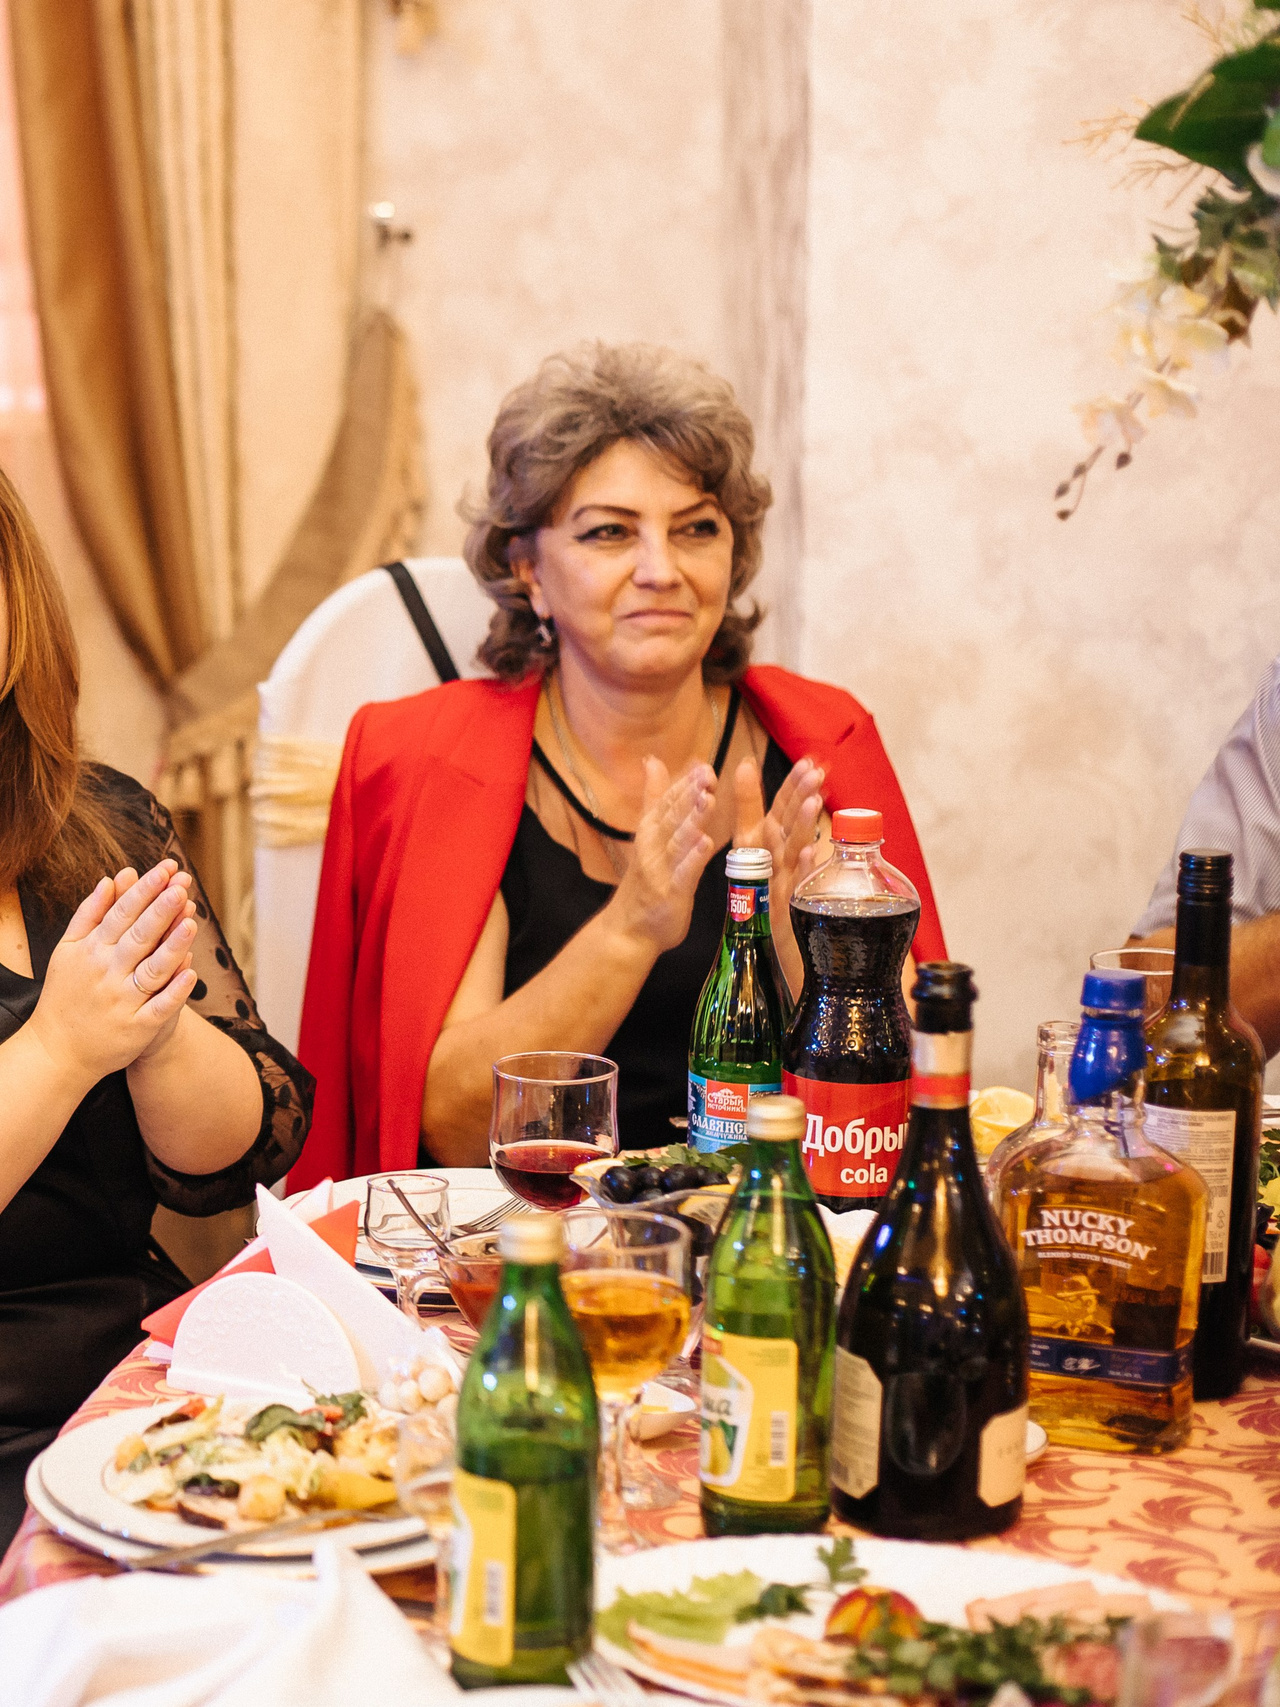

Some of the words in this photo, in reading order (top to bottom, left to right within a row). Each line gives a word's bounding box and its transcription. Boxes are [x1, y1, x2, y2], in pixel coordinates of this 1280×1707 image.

[730, 899, 747, 914] 1500
[707, 1093, 744, 1106] Старый
[840, 1163, 888, 1184] cola
[1040, 1209, 1136, 1236] NUCKY
[1021, 1228, 1153, 1260] THOMPSON
[1037, 1251, 1072, 1259] BLENDED
[1072, 1252, 1101, 1262] SCOTCH
